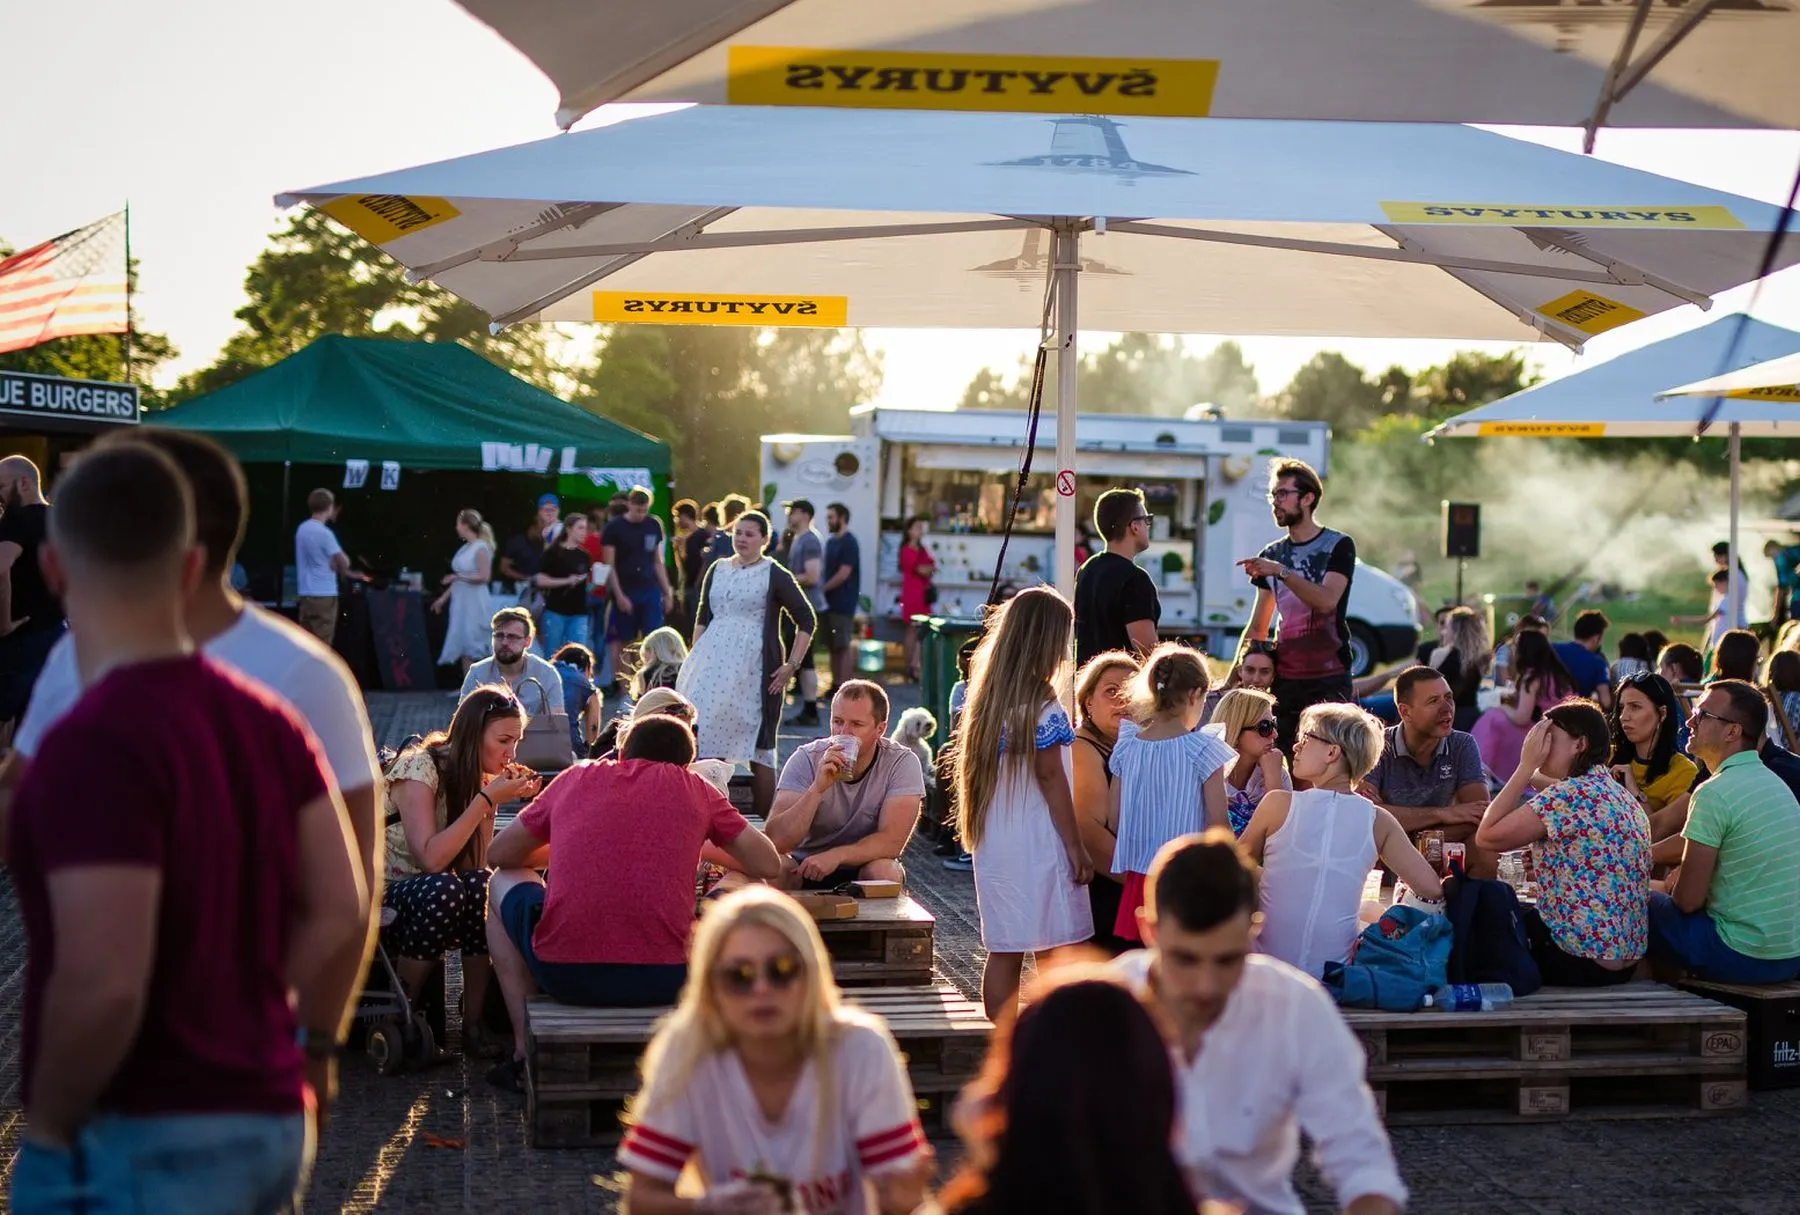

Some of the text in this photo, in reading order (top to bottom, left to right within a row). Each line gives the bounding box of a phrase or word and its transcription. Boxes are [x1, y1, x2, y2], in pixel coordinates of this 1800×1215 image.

[31, 381, 134, 417] BURGERS
[383, 468, 398, 486] K
[1710, 1036, 1733, 1049] EPAL
